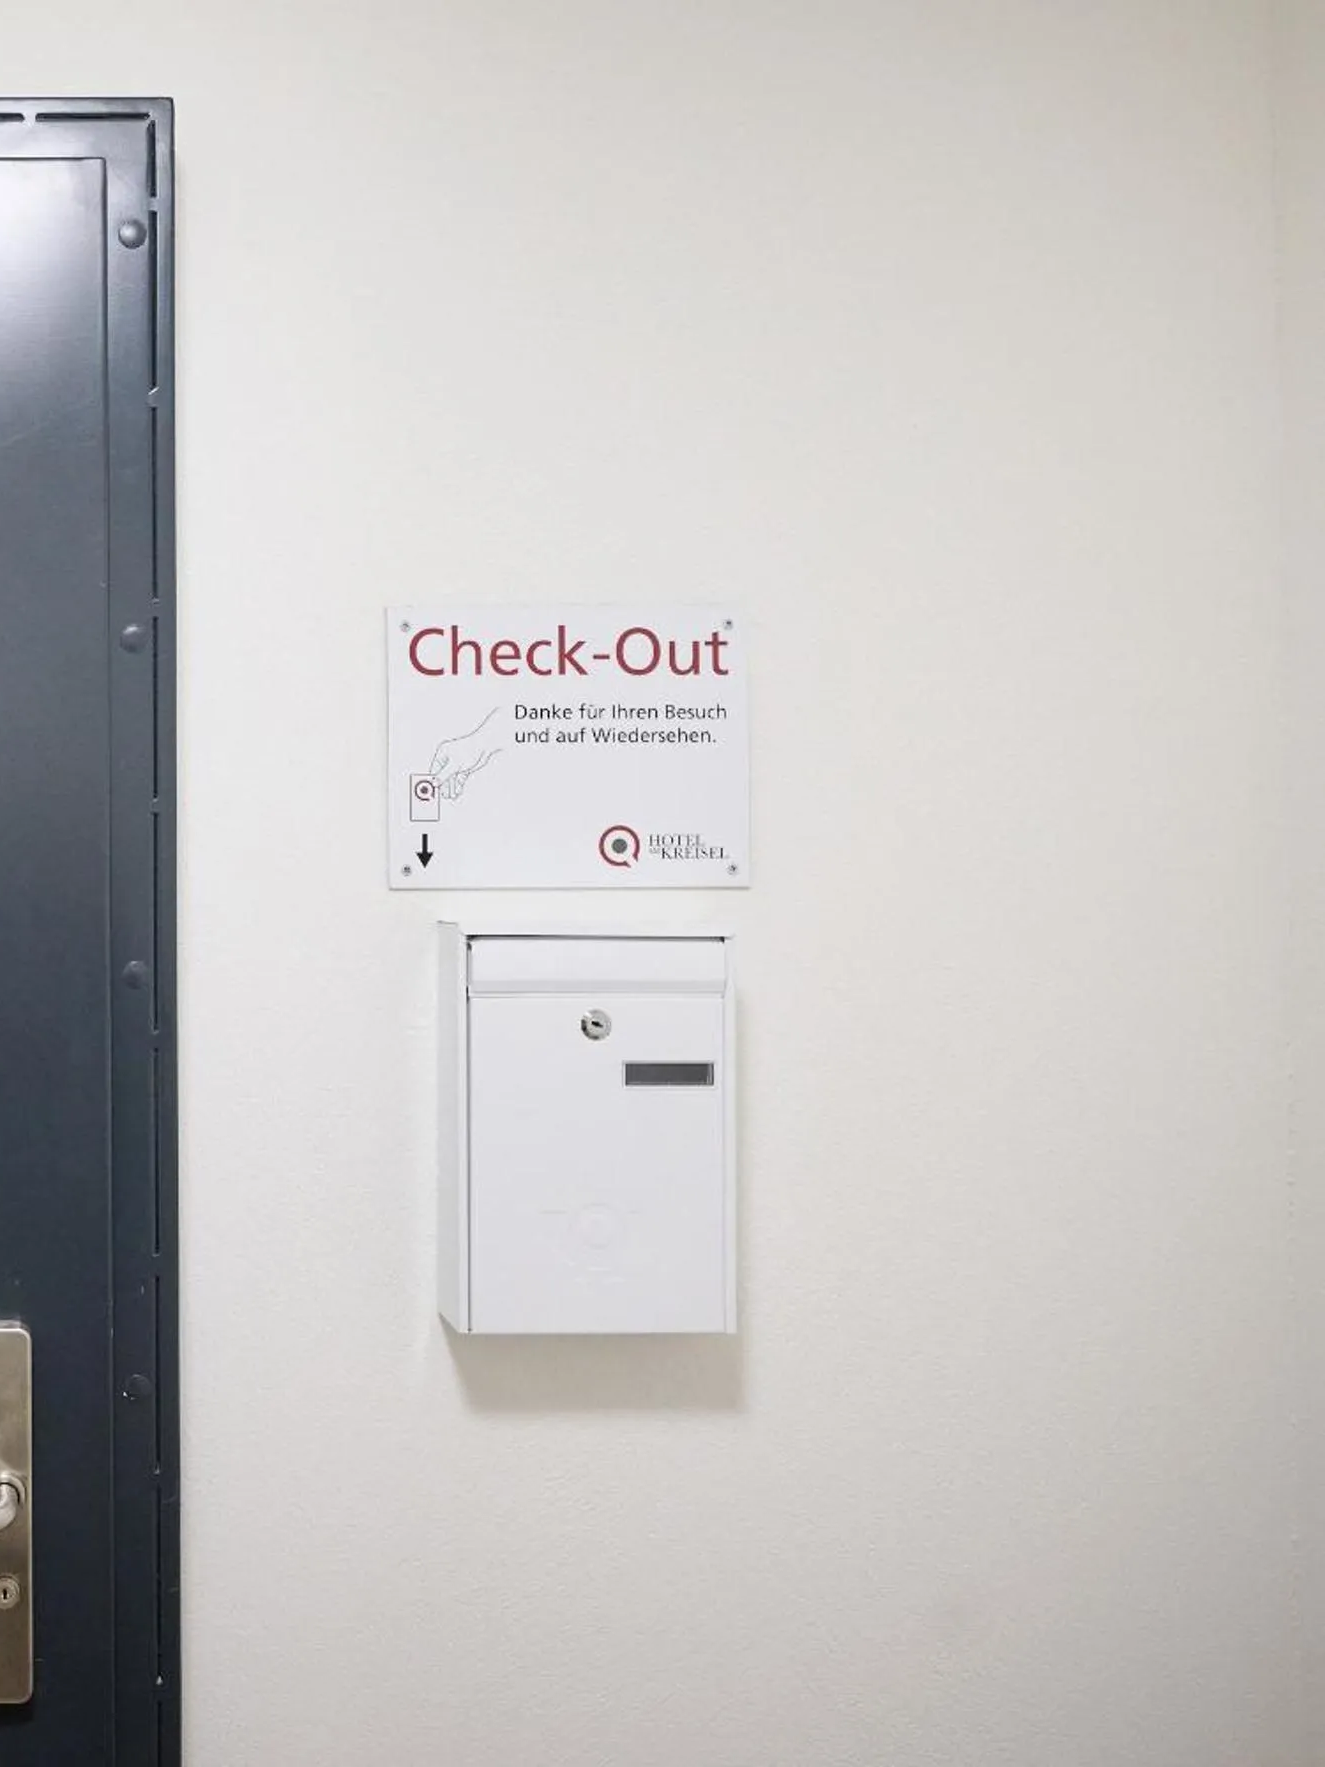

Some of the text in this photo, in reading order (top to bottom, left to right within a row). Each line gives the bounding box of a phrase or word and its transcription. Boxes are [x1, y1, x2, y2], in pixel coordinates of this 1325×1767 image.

[408, 624, 730, 676] Check-Out
[514, 703, 728, 720] Danke für Ihren Besuch
[514, 727, 717, 744] und auf Wiedersehen.
[649, 833, 705, 847] HOTEL
[661, 846, 729, 860] KREISEL
